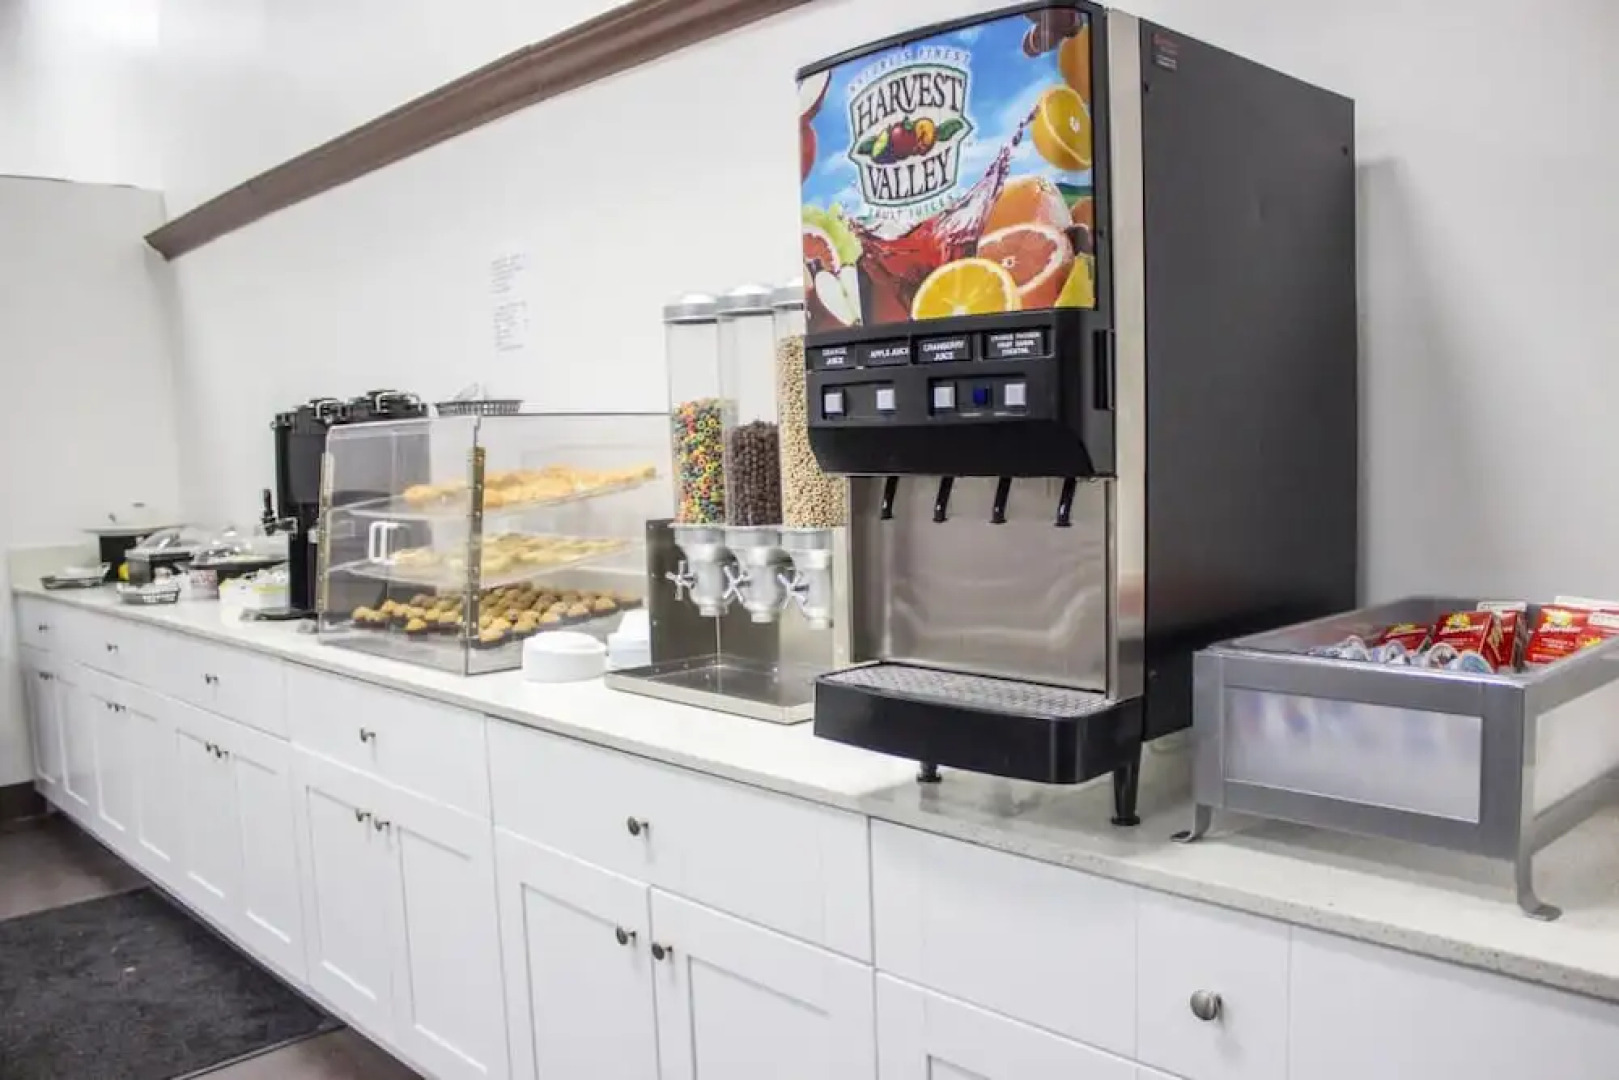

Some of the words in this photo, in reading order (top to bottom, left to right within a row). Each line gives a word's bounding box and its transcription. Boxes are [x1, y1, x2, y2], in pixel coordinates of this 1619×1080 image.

[857, 71, 963, 137] HARVEST
[866, 145, 952, 200] VALLEY
[922, 340, 965, 352] CRANBERRY
[826, 356, 844, 366] JUICE
[933, 352, 954, 362] JUICE
